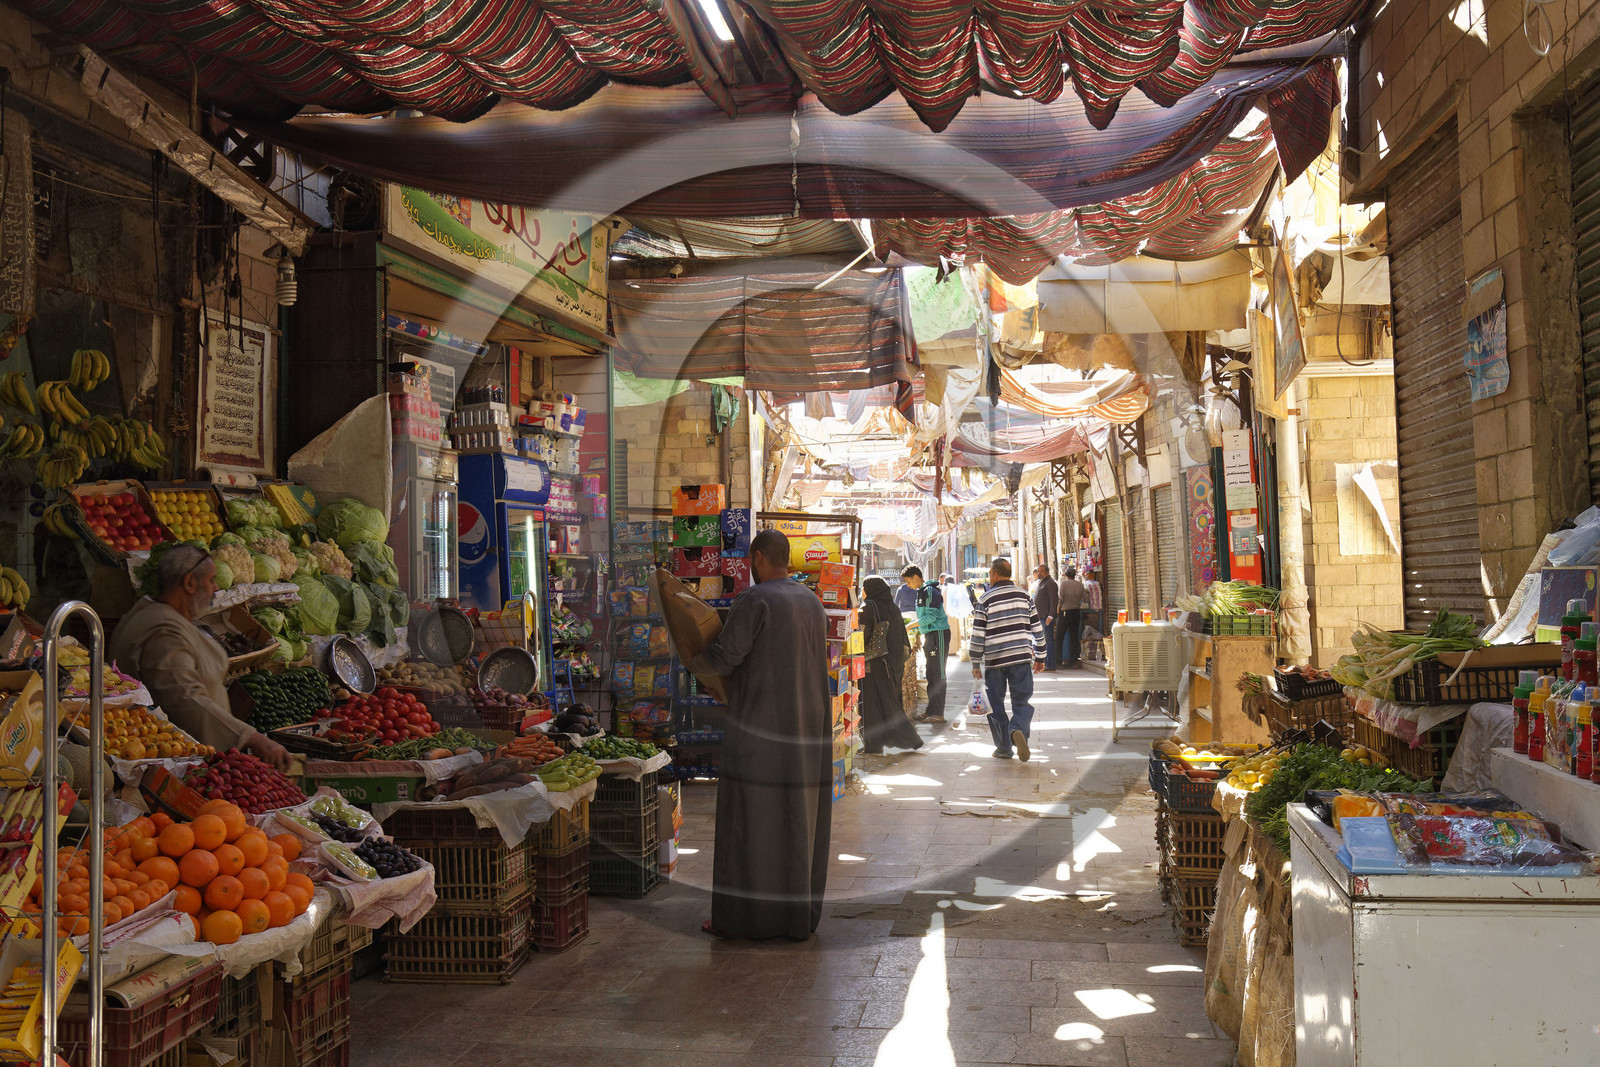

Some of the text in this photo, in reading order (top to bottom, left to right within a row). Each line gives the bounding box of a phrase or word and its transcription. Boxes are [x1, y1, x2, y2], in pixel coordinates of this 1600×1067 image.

[401, 190, 420, 224] جبن
[422, 218, 462, 255] مجمدات
[463, 238, 497, 262] معلبات
[543, 219, 588, 275] خير
[780, 522, 804, 530] فوري
[803, 550, 829, 561] شيبسي
[5, 721, 27, 752] halley
